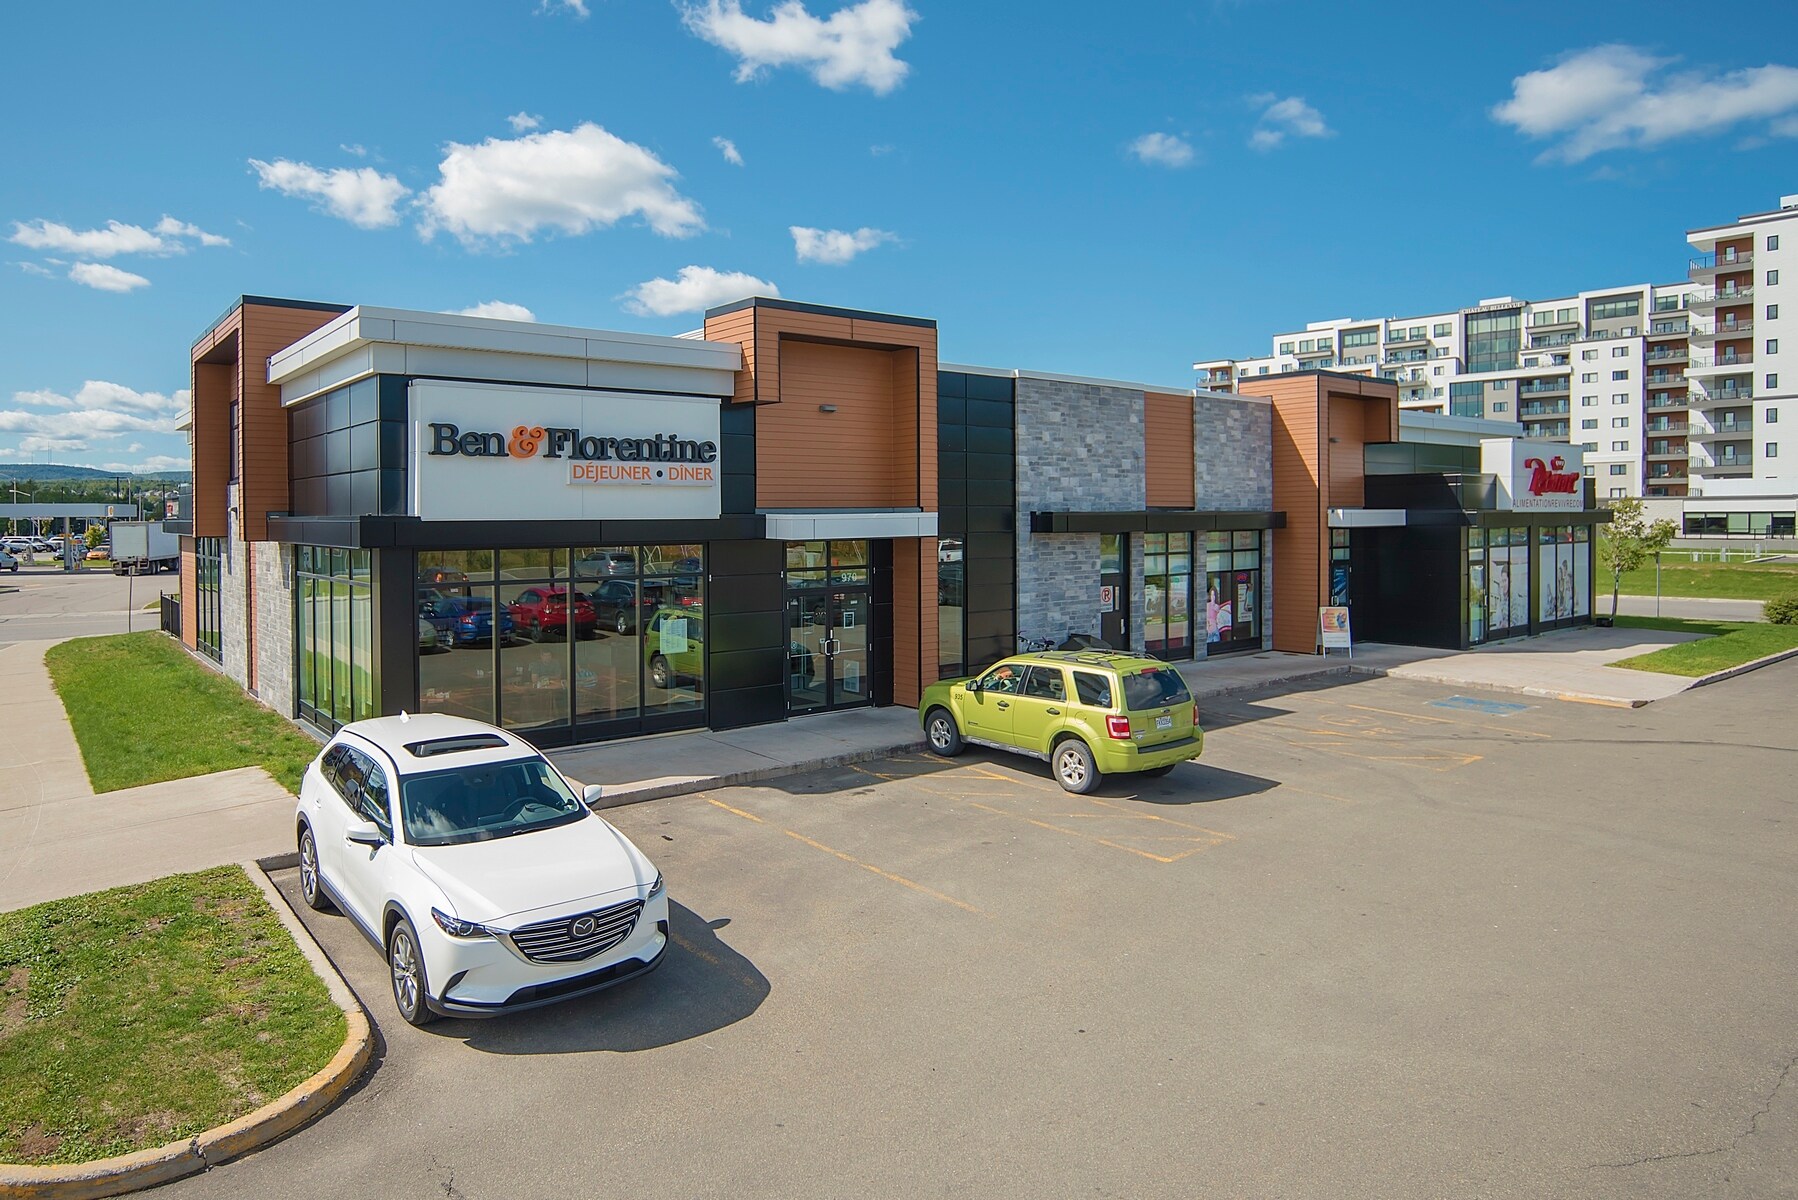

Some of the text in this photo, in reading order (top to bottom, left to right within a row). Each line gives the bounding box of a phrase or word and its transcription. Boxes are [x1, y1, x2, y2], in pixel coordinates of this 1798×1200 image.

[572, 461, 714, 483] DÉJEUNER DÎNER
[841, 573, 857, 582] 970
